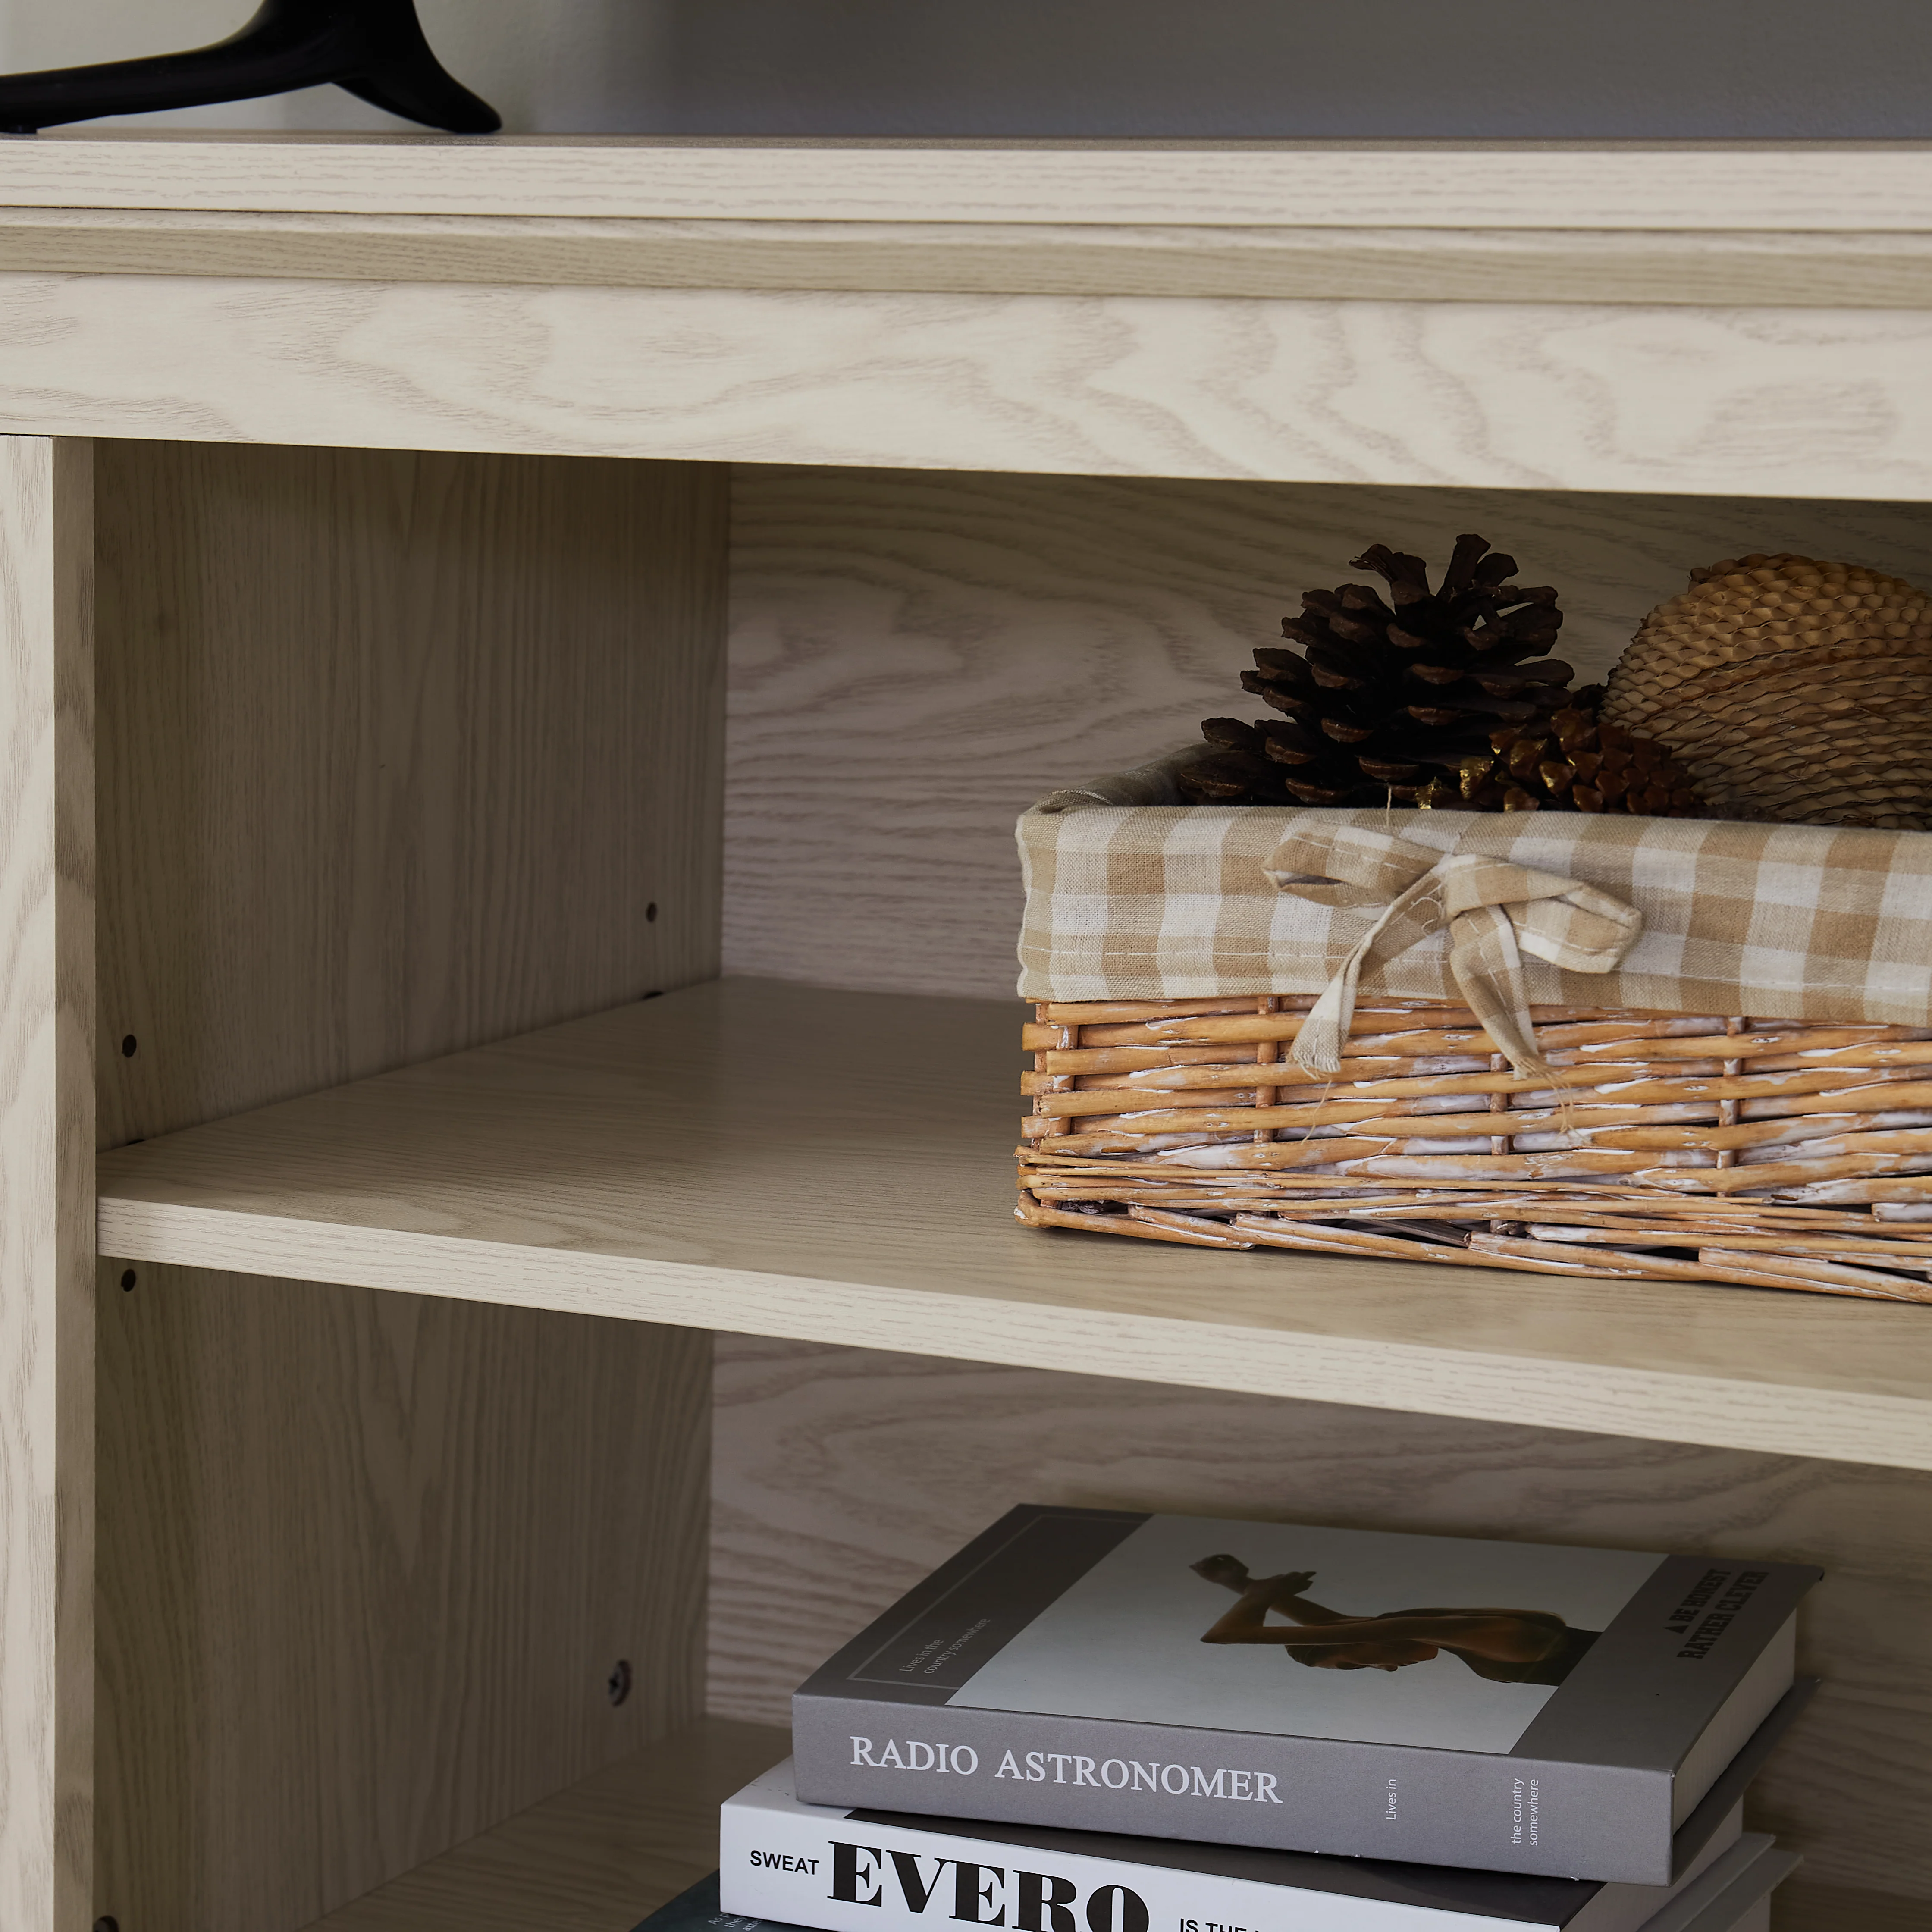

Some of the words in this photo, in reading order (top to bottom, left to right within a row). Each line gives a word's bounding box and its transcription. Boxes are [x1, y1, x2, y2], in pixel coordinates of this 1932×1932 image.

[1680, 1568, 1731, 1608] HONEST
[1669, 1608, 1701, 1622] BE
[1677, 1613, 1736, 1659] RATHER
[1714, 1571, 1769, 1611] CLEVER
[899, 1656, 925, 1672] Lives
[925, 1639, 944, 1650] the
[924, 1648, 956, 1674] country
[951, 1618, 991, 1650] somewhere
[850, 1736, 978, 1775] RADIO
[994, 1746, 1283, 1803] ASTRONOMER
[1386, 1779, 1396, 1789] in
[1386, 1792, 1396, 1820] Lives
[1512, 1778, 1525, 1822] country
[1527, 1779, 1539, 1846] somewhere
[1510, 1825, 1521, 1844] the
[750, 1850, 819, 1875] SWEAT
[827, 1841, 1149, 1932] EVERO
[1180, 1918, 1198, 1932] IS
